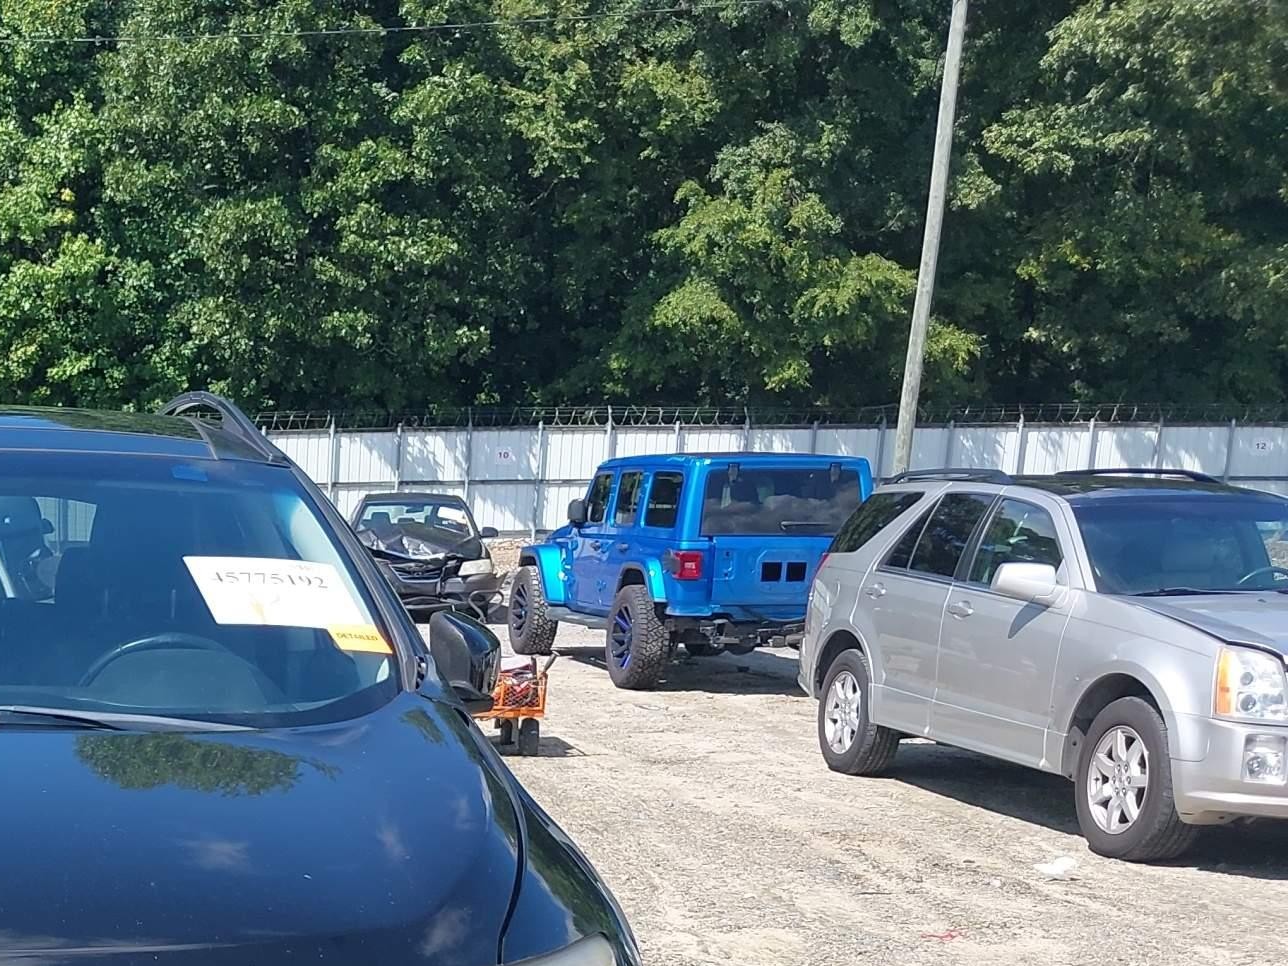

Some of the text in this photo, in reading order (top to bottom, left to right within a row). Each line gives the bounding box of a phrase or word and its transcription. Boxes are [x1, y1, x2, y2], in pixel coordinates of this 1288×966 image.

[1255, 442, 1267, 451] 12
[498, 451, 510, 460] 10
[211, 571, 328, 588] 45775192
